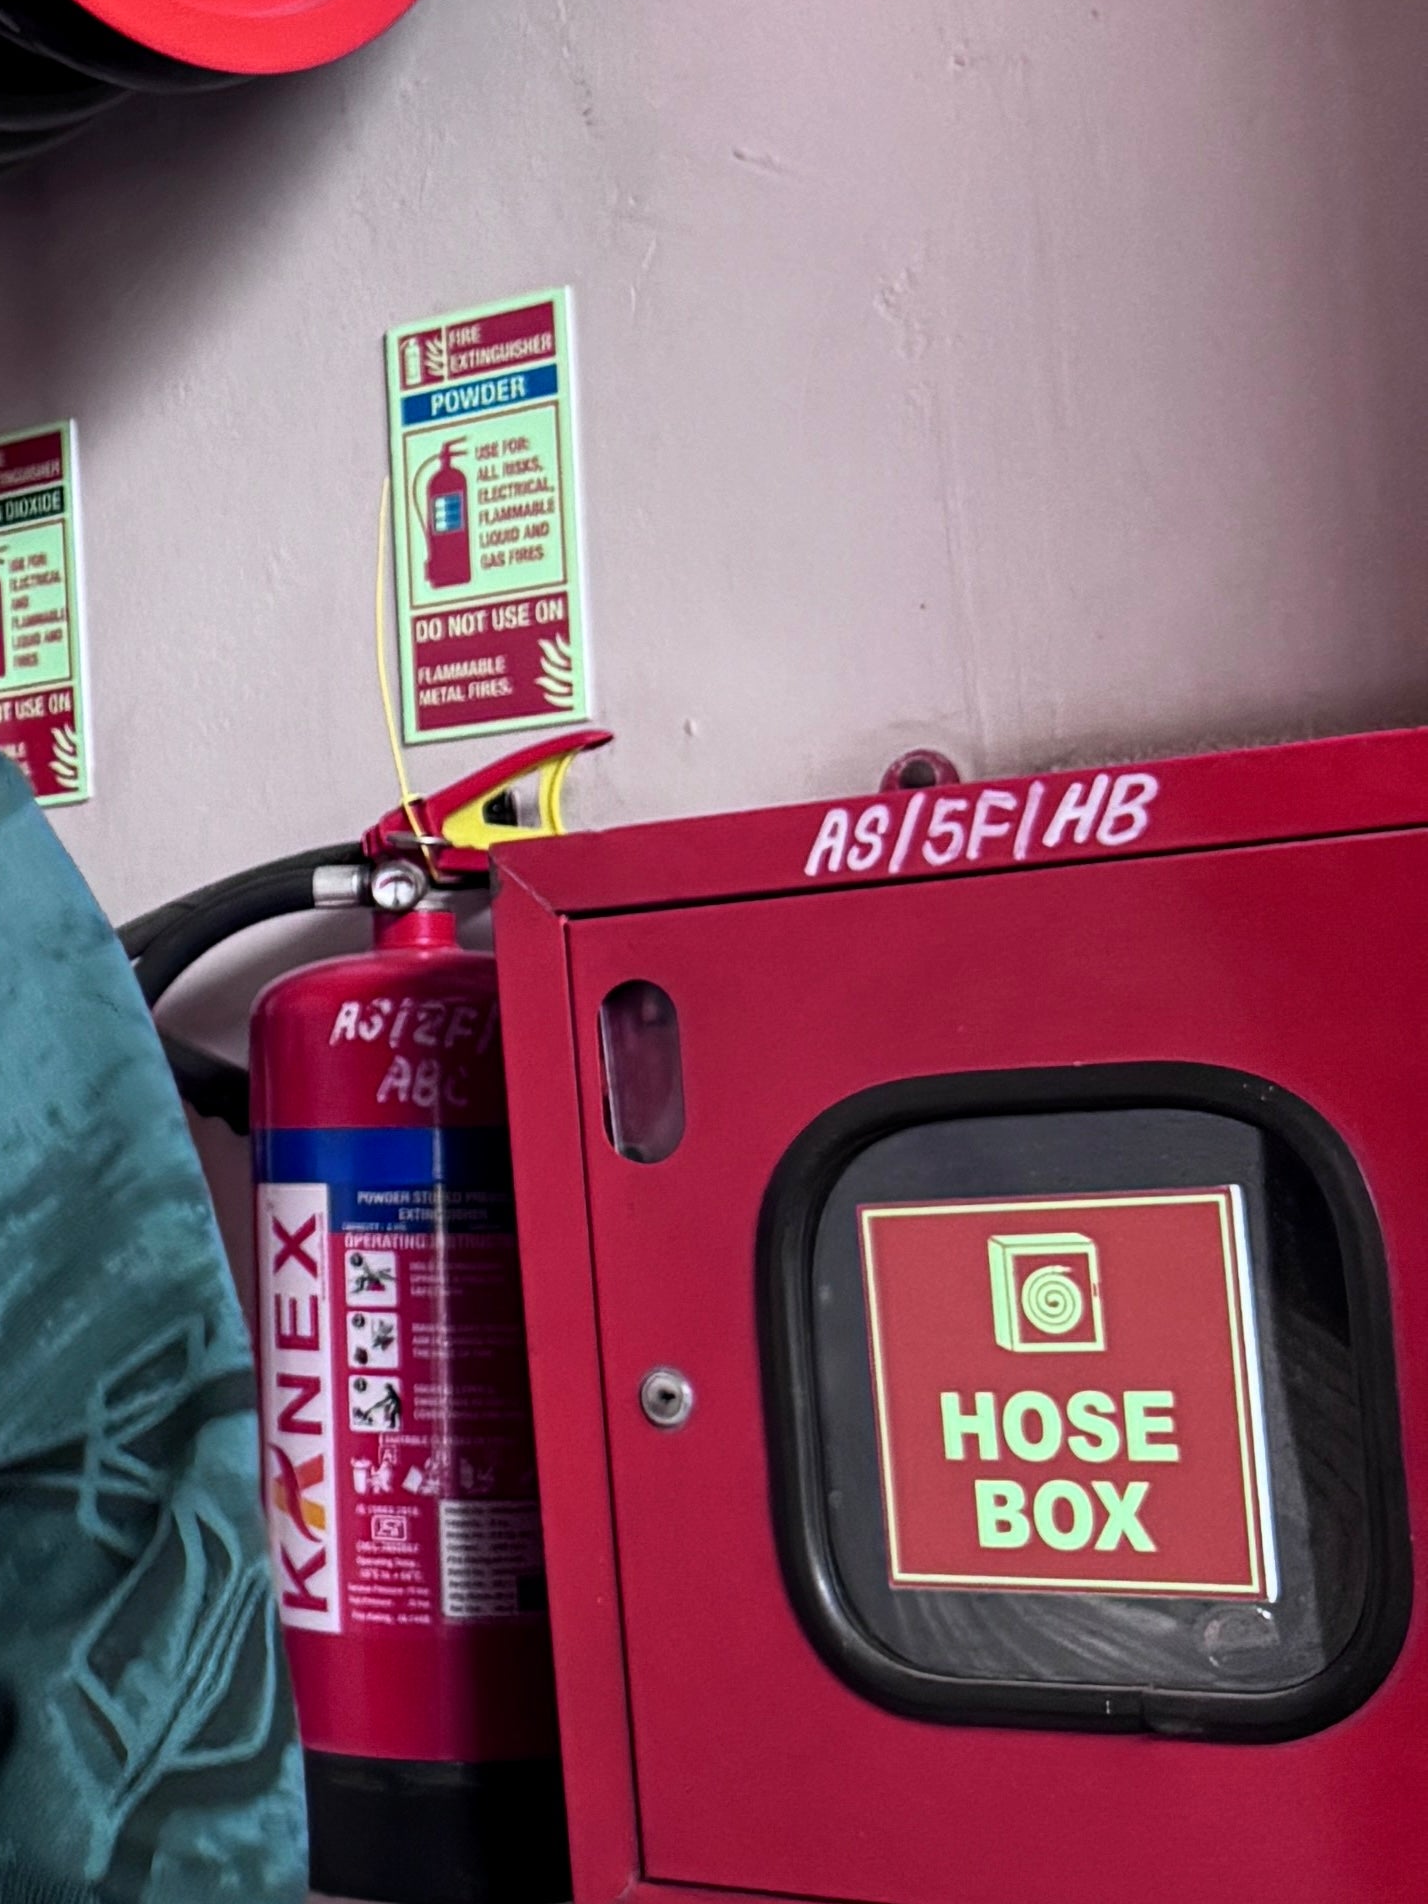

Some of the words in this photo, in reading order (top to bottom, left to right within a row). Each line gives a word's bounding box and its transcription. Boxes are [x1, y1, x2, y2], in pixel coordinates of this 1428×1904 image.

[448, 324, 481, 348] FIRE
[449, 332, 552, 374] EXTINGUISHER
[430, 375, 526, 417] POWDER
[475, 441, 499, 462] USE
[477, 463, 499, 482] ALL
[5, 490, 61, 521] DIOXIDE
[478, 497, 555, 526] FLAMMABLE
[479, 526, 520, 548] LIQUID
[523, 521, 550, 540] AND
[480, 551, 505, 570] GAS
[415, 617, 442, 643] DO
[447, 609, 488, 638] NOT
[491, 602, 531, 631] USE
[535, 597, 564, 624] ON
[417, 654, 507, 685] FLAMMABLE
[15, 695, 45, 720] USE
[48, 691, 71, 714] ON
[419, 684, 466, 707] METAL
[344, 1232, 426, 1251] OPERATING
[269, 1212, 329, 1613] KANEX
[940, 1389, 1181, 1463] HOSE
[975, 1479, 1158, 1553] BOX
